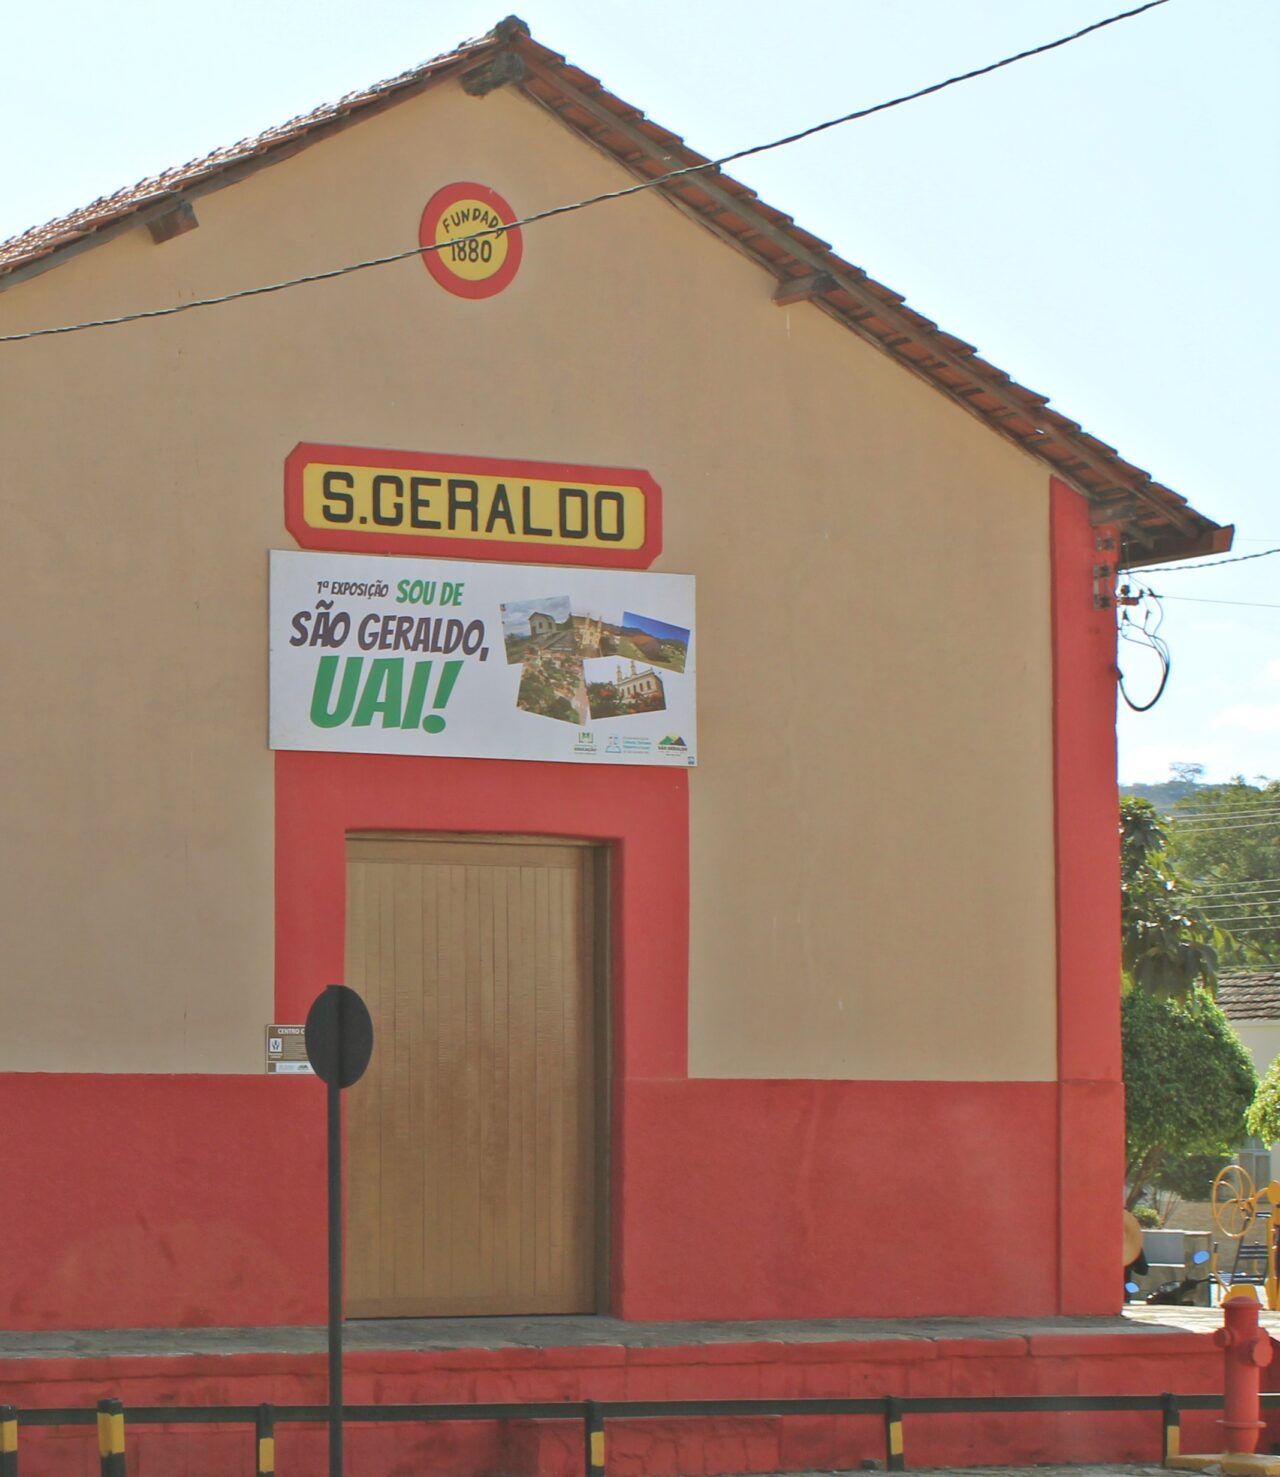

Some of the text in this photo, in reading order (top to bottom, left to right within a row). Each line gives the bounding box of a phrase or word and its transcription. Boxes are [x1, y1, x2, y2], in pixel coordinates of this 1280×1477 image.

[450, 238, 492, 263] 1880
[322, 471, 625, 541] S.GERALDO
[317, 579, 465, 607] 1ª EXPOSIÇÃO SOU DE
[289, 600, 490, 662] SÃO GERALDO,
[310, 655, 465, 734] UAI!
